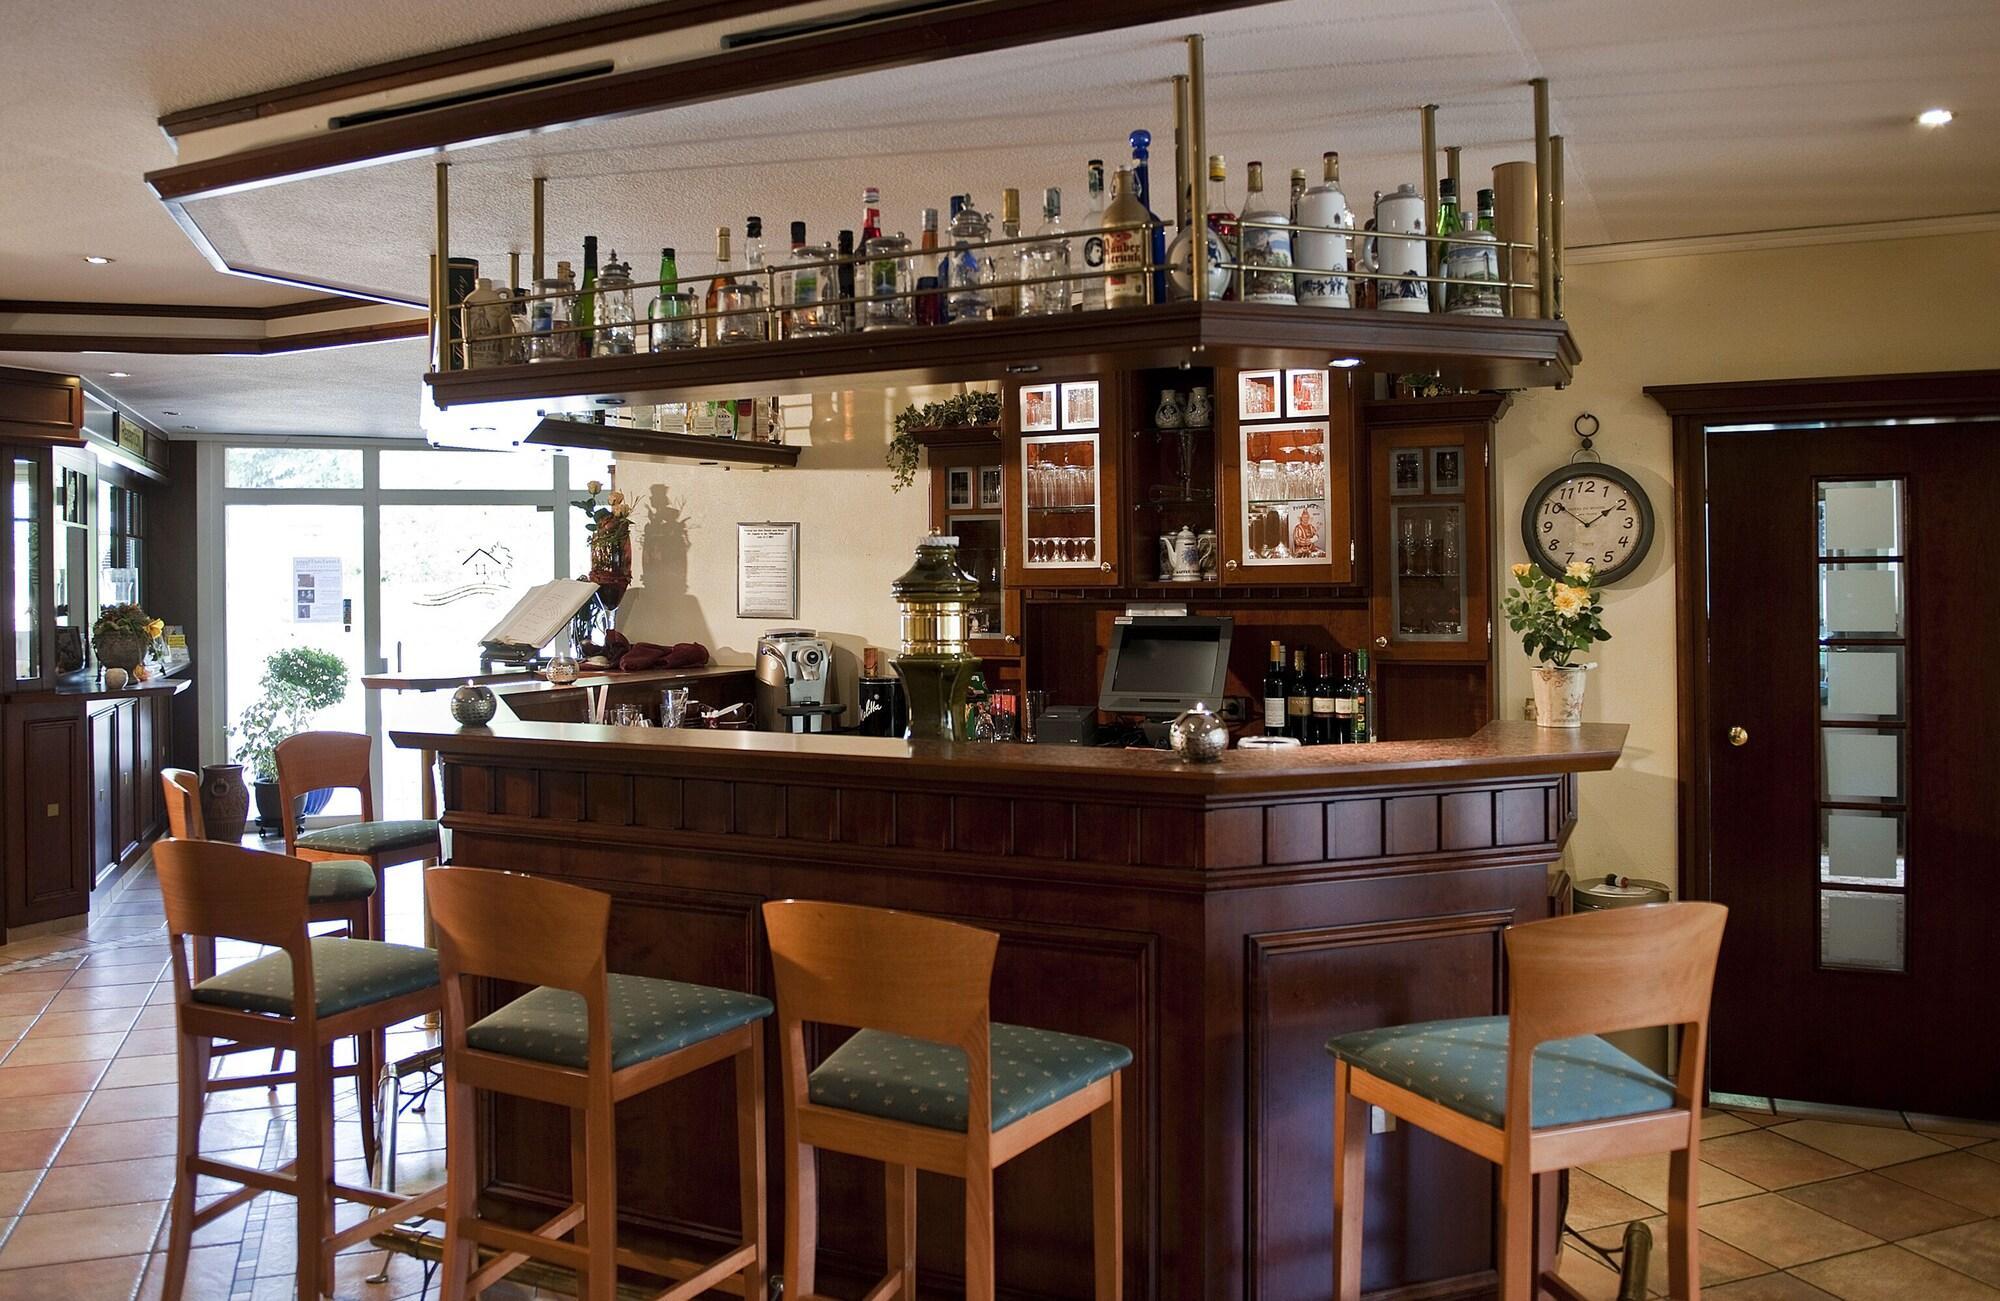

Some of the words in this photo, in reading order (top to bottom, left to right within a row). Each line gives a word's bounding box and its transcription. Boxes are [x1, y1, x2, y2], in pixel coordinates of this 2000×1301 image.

[1560, 487, 1575, 500] 11
[1577, 480, 1595, 494] 12
[1602, 485, 1609, 498] 1
[1543, 502, 1562, 515] 10
[1616, 498, 1627, 511] 2
[1543, 521, 1553, 534] 9
[1623, 516, 1634, 529] 3
[1548, 538, 1560, 551] 8
[1618, 536, 1629, 548] 4
[1565, 551, 1575, 564] 7
[1603, 550, 1614, 563] 5
